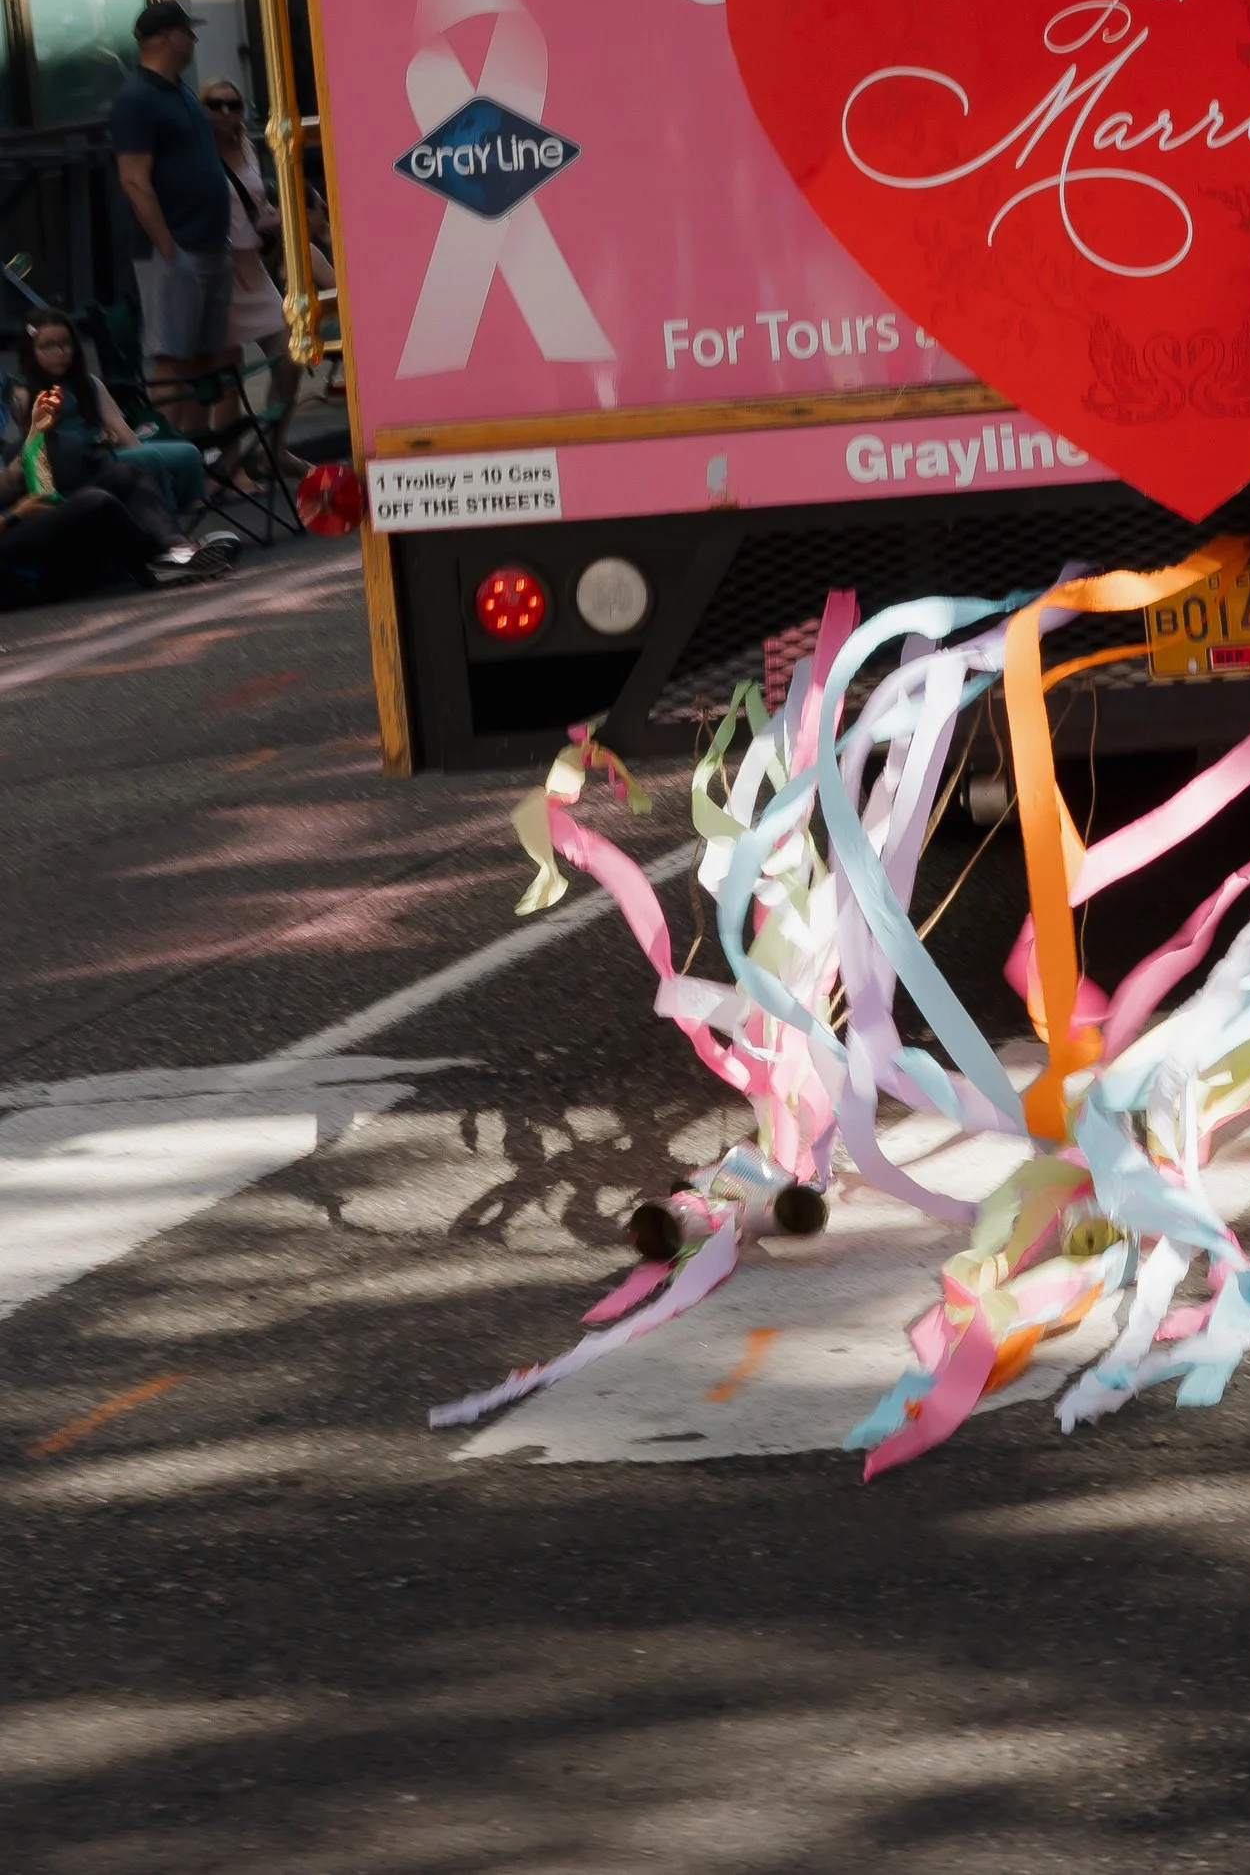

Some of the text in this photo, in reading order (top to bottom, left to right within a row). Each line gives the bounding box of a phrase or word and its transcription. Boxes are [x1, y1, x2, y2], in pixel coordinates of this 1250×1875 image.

[411, 133, 564, 180] Gray Line
[663, 317, 745, 370] For
[755, 309, 900, 361] Tours
[376, 473, 386, 494] 1
[392, 469, 457, 494] Trolley
[481, 465, 502, 486] 10
[508, 463, 553, 485] Cars
[377, 489, 556, 521] OFF THE STREETS
